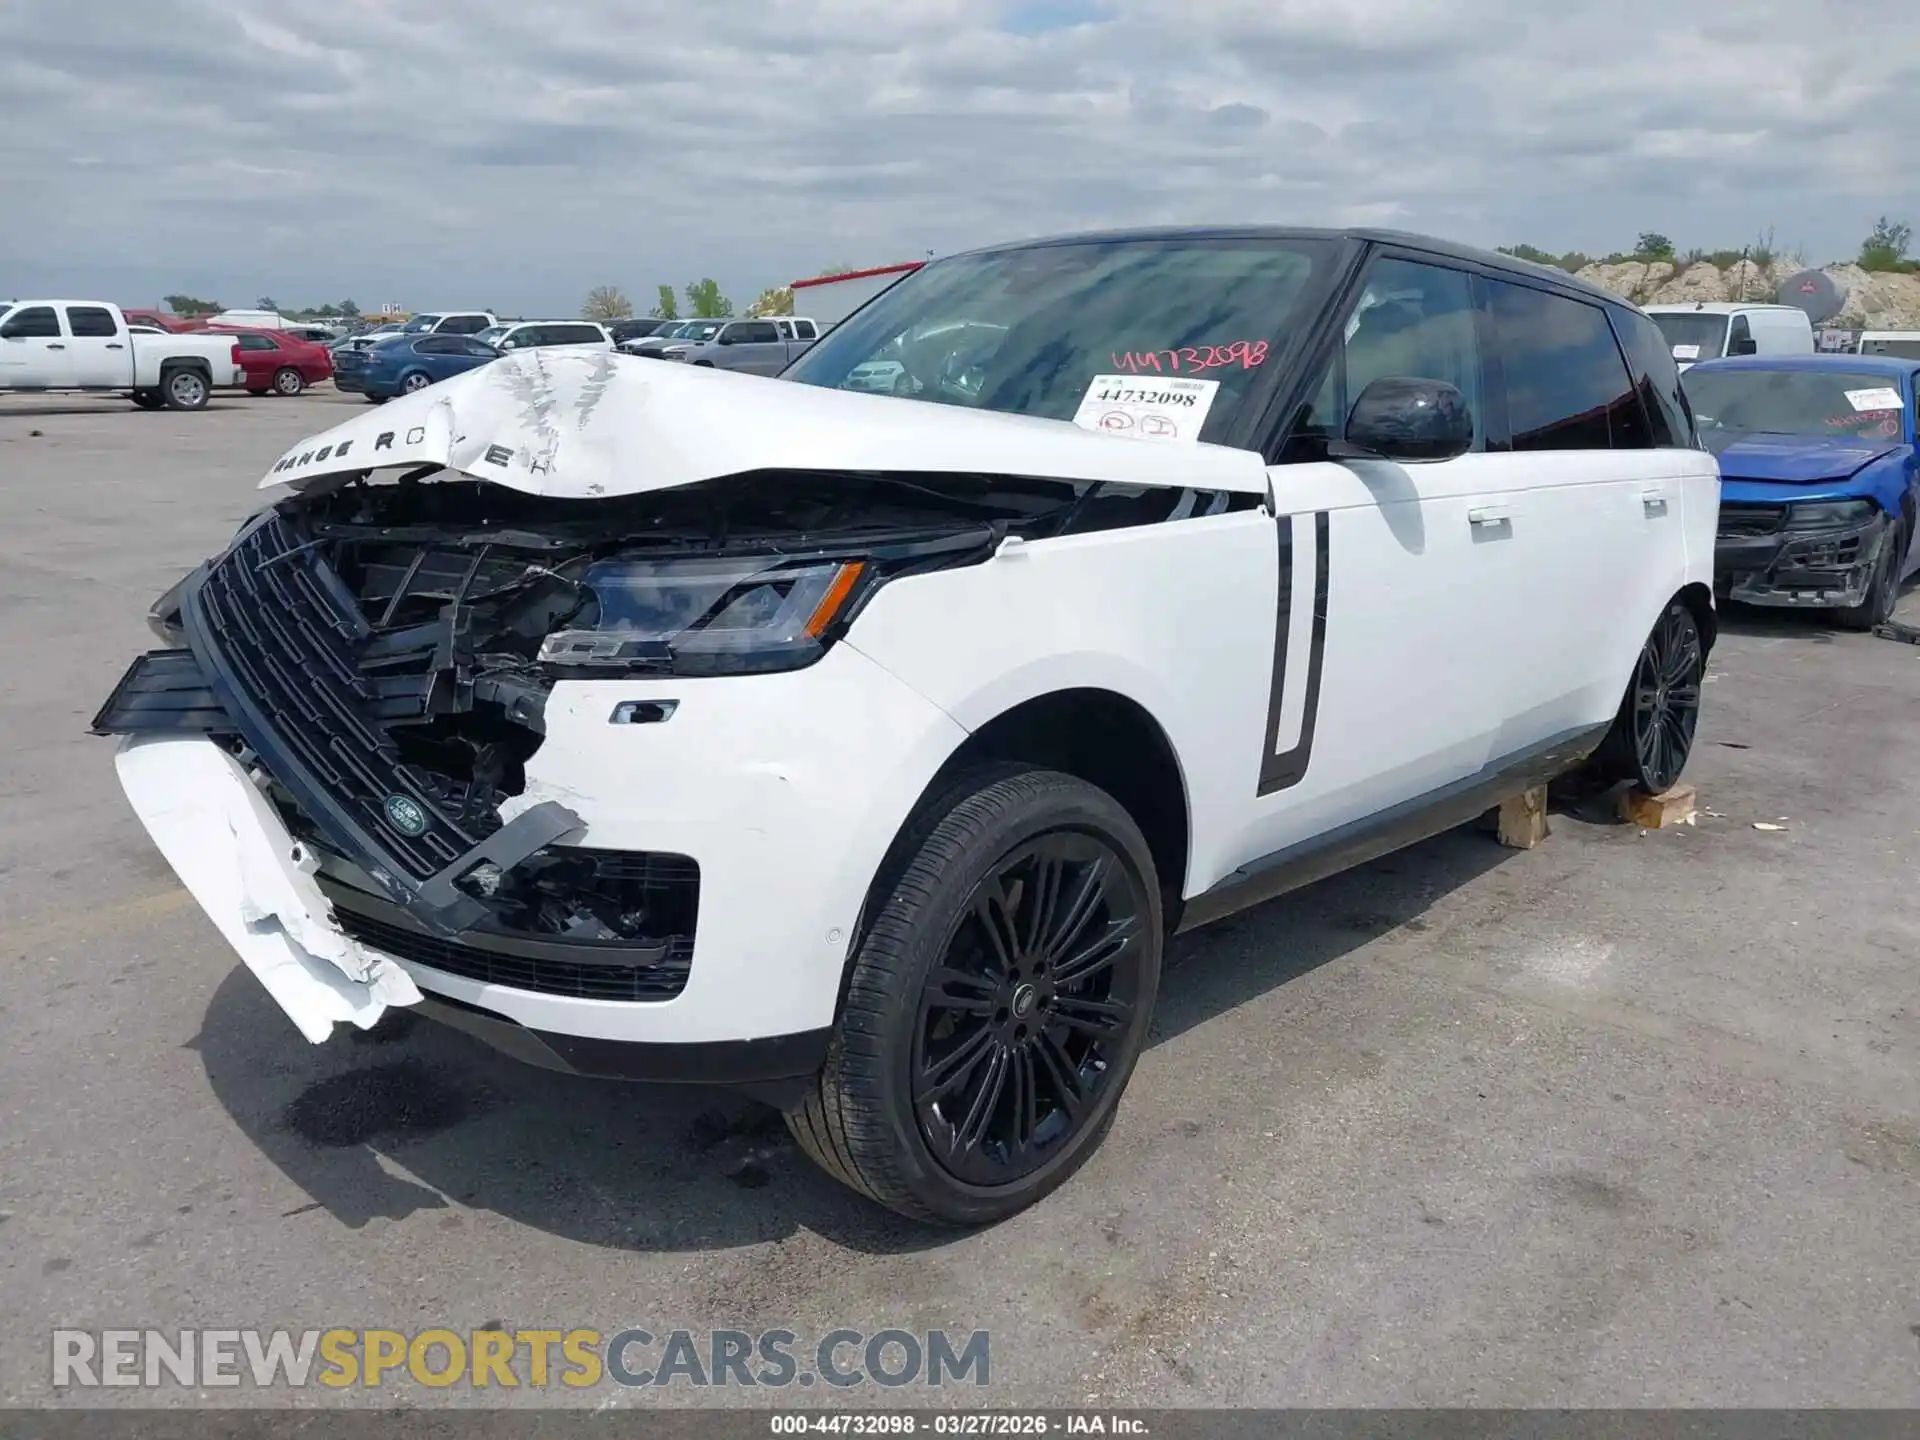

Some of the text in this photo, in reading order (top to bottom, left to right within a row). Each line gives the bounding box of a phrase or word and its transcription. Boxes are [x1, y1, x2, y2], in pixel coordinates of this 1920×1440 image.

[1112, 340, 1268, 373] 44732098
[1097, 389, 1197, 407] 44732098
[273, 439, 354, 473] RANGE
